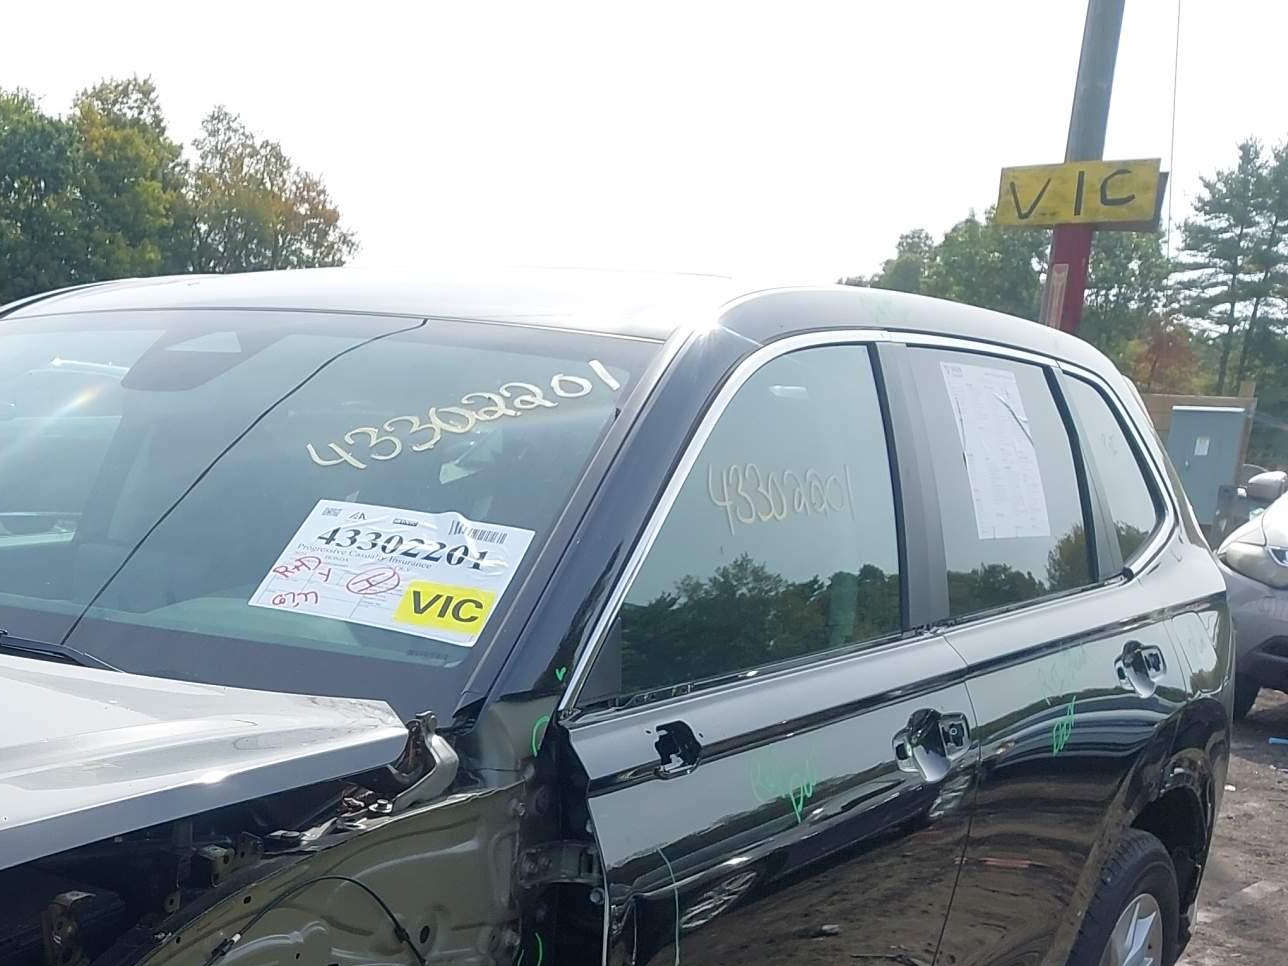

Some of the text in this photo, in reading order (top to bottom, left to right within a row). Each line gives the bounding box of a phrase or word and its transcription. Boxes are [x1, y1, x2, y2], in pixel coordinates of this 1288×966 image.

[1010, 169, 1136, 219] VIC
[306, 359, 621, 470] 43302201
[707, 463, 856, 537] 43302201
[297, 543, 348, 558] Progressive
[387, 555, 432, 569] Insurance
[317, 526, 489, 571] 43302201
[411, 590, 484, 624] VIC
